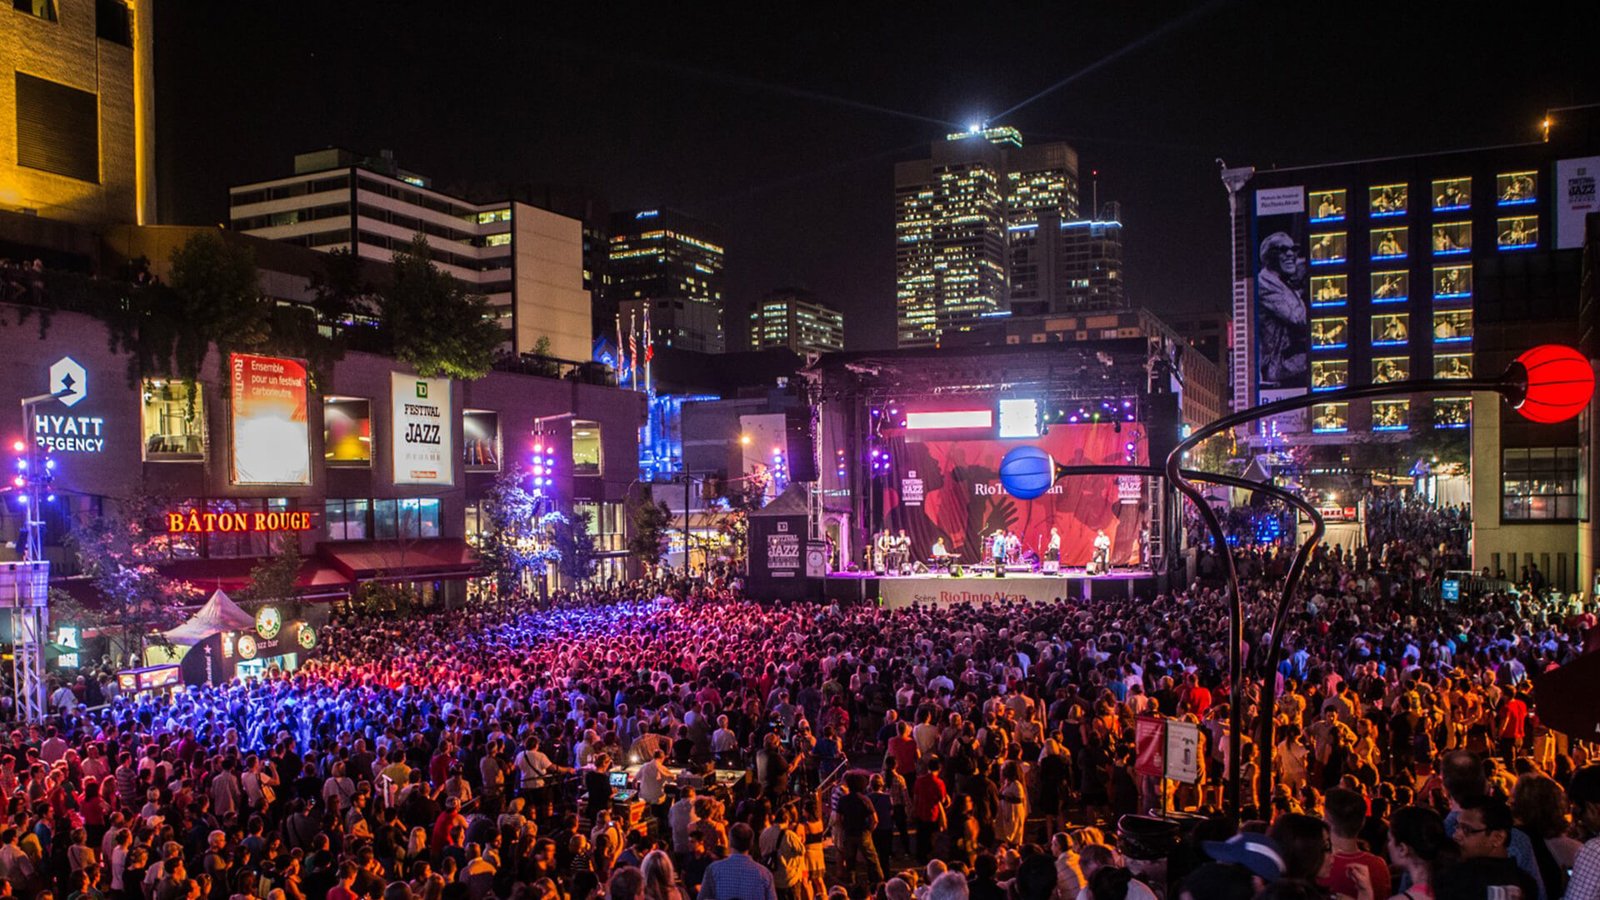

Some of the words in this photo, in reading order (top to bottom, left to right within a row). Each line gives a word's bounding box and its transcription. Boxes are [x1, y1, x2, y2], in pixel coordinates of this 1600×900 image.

[251, 360, 284, 374] Ensemble
[251, 375, 267, 385] pour
[268, 376, 278, 385] un
[279, 375, 302, 387] festival
[404, 404, 440, 417] FESTIVAL
[35, 414, 103, 436] HYATT
[405, 423, 440, 444] JAZZ
[36, 436, 103, 451] REGENCY
[169, 508, 247, 532] BÂTON
[254, 512, 311, 531] ROUGE
[767, 544, 800, 558] JAZZ
[914, 594, 936, 602] Scène
